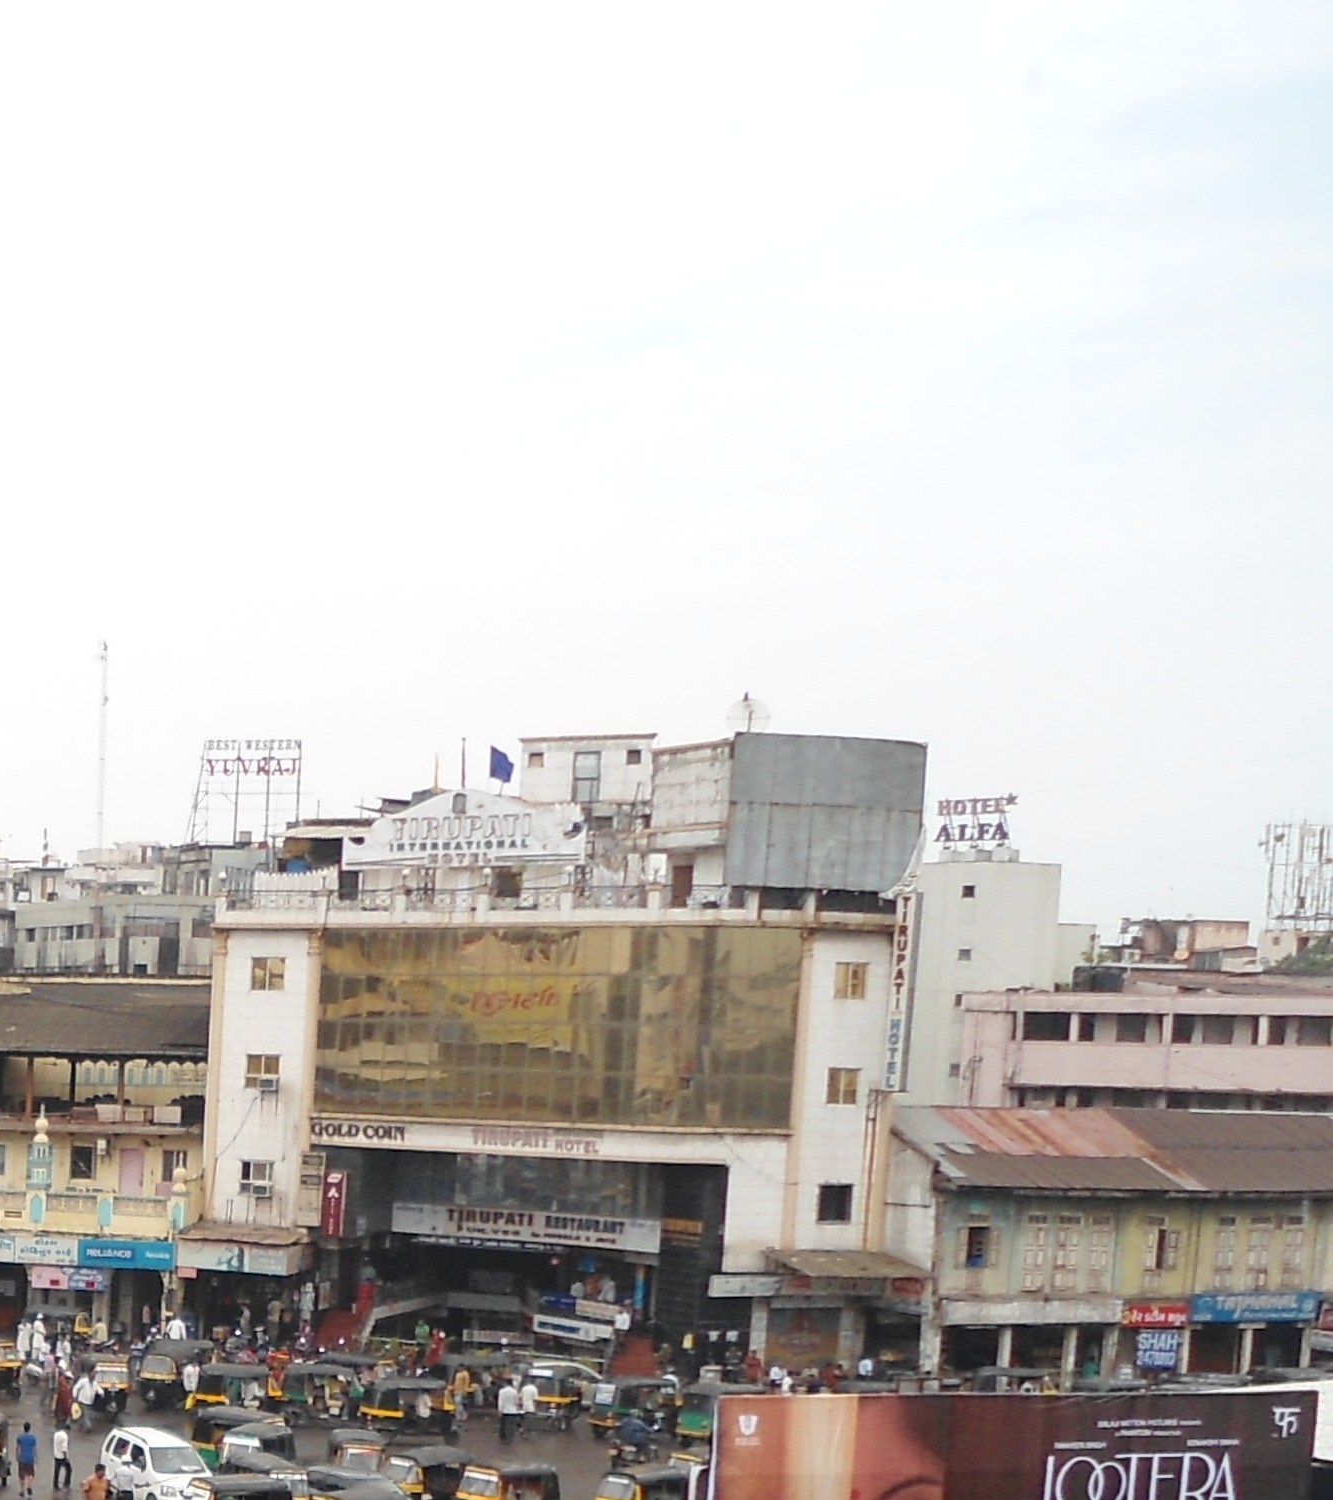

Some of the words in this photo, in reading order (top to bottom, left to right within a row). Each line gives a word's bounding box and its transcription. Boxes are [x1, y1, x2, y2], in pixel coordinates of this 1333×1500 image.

[207, 740, 236, 751] BEST
[244, 739, 302, 751] WESTERN
[205, 757, 301, 777] YUVRAJ
[937, 797, 1005, 816] HOTEL
[391, 813, 532, 842] TIRUPATI
[933, 823, 1010, 843] ALFA
[389, 839, 529, 853] INTERNATIONAL
[426, 853, 496, 866] HOTEL
[892, 895, 911, 1011] TIRUPATI
[885, 1018, 902, 1089] HOTEL
[311, 1121, 360, 1139] GOLD
[362, 1122, 406, 1142] COIN
[472, 1127, 550, 1150] TIRUPATI
[554, 1137, 600, 1154] HOTEL
[447, 1206, 535, 1229] TIRUPATI
[544, 1214, 626, 1236] RESTAURANT
[86, 1247, 133, 1260] RELIANCE
[1137, 1333, 1178, 1350] SHAH
